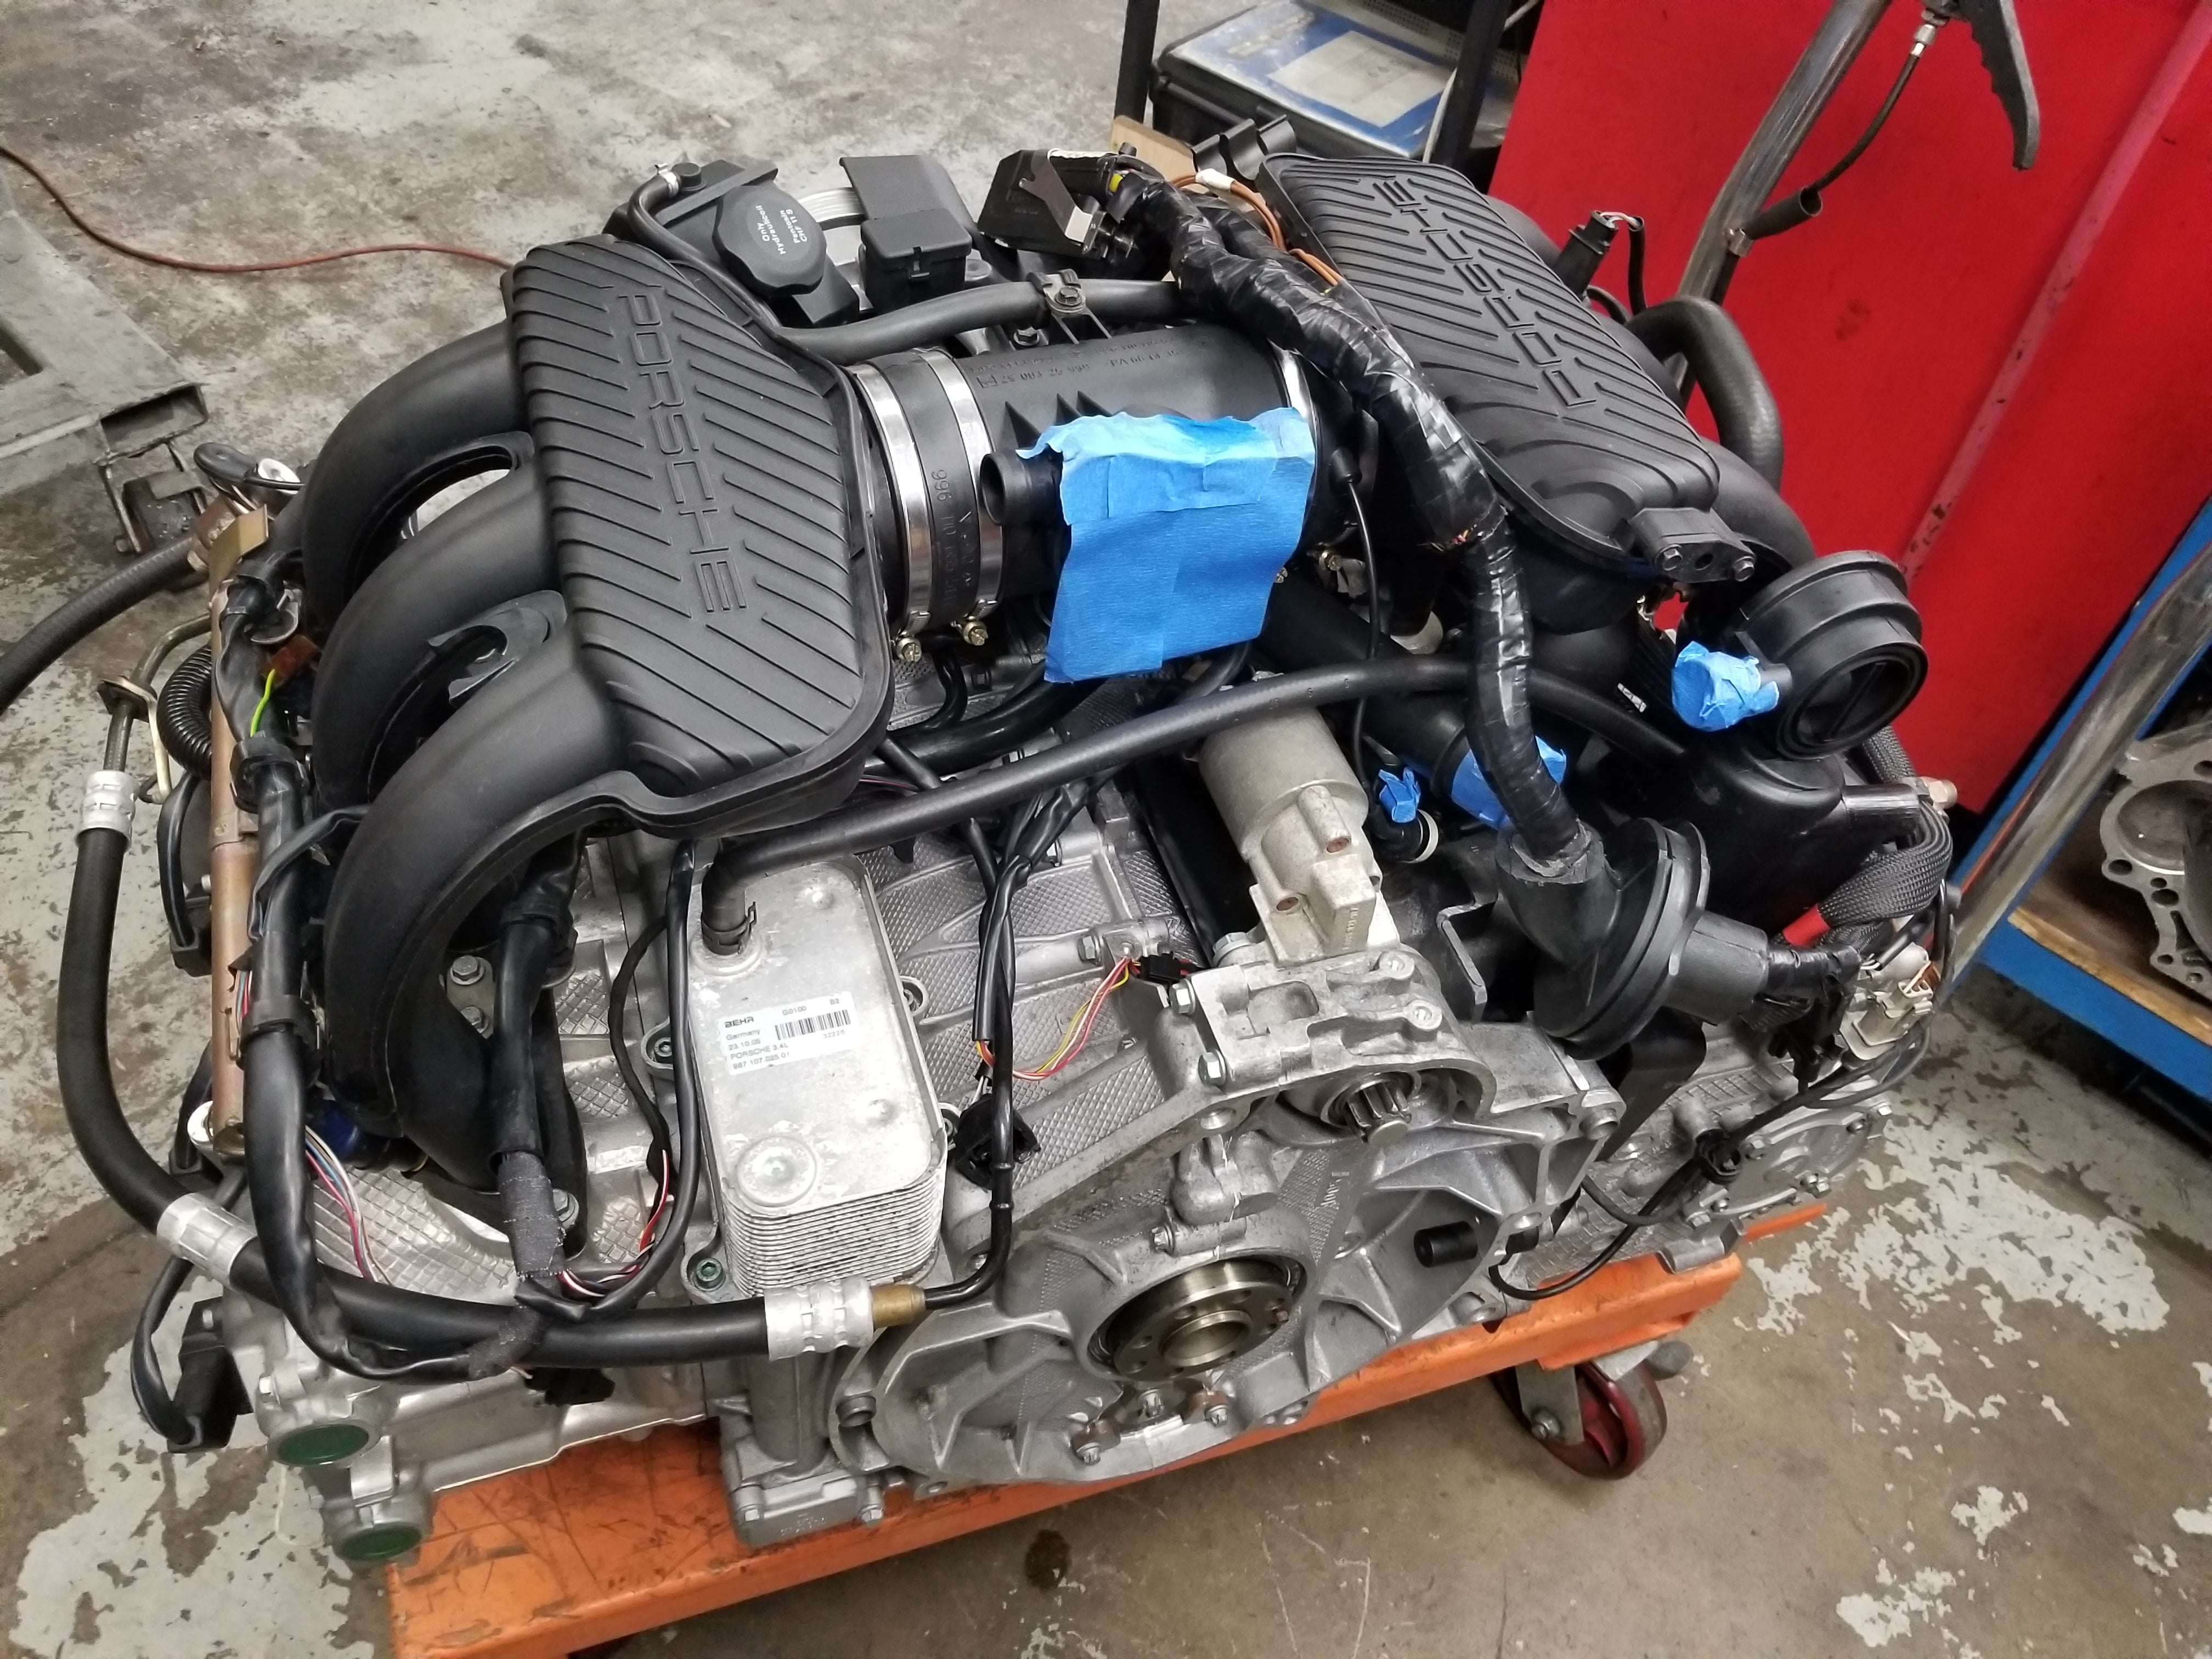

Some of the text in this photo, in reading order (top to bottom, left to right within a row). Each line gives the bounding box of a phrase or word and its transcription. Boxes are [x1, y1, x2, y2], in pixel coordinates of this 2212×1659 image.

[757, 222, 770, 241] Only
[780, 210, 800, 243] Pentosin
[795, 225, 807, 241] CHF
[1373, 178, 1595, 407] PORSCHE
[618, 295, 747, 612] PORSCHE
[931, 469, 951, 502] 996
[725, 1016, 754, 1028] BEHR
[726, 1029, 760, 1041] Germany
[730, 1046, 771, 1060] PORSCHE
